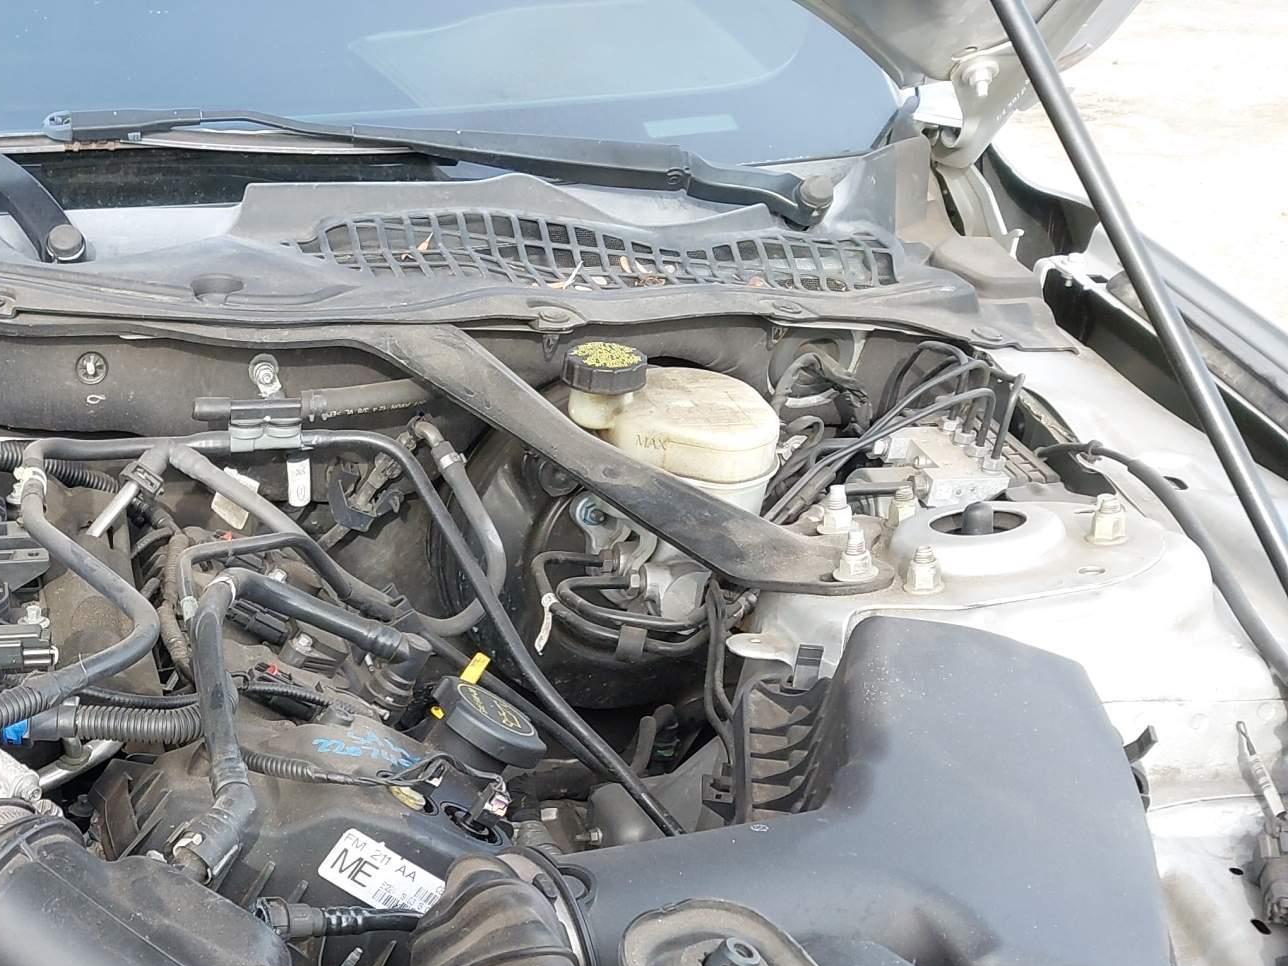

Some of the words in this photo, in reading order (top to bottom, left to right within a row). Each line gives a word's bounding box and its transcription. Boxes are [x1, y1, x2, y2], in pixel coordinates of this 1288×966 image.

[633, 432, 666, 450] MAX
[330, 848, 379, 887] ME
[370, 849, 392, 866] 211
[395, 865, 416, 882] AA
